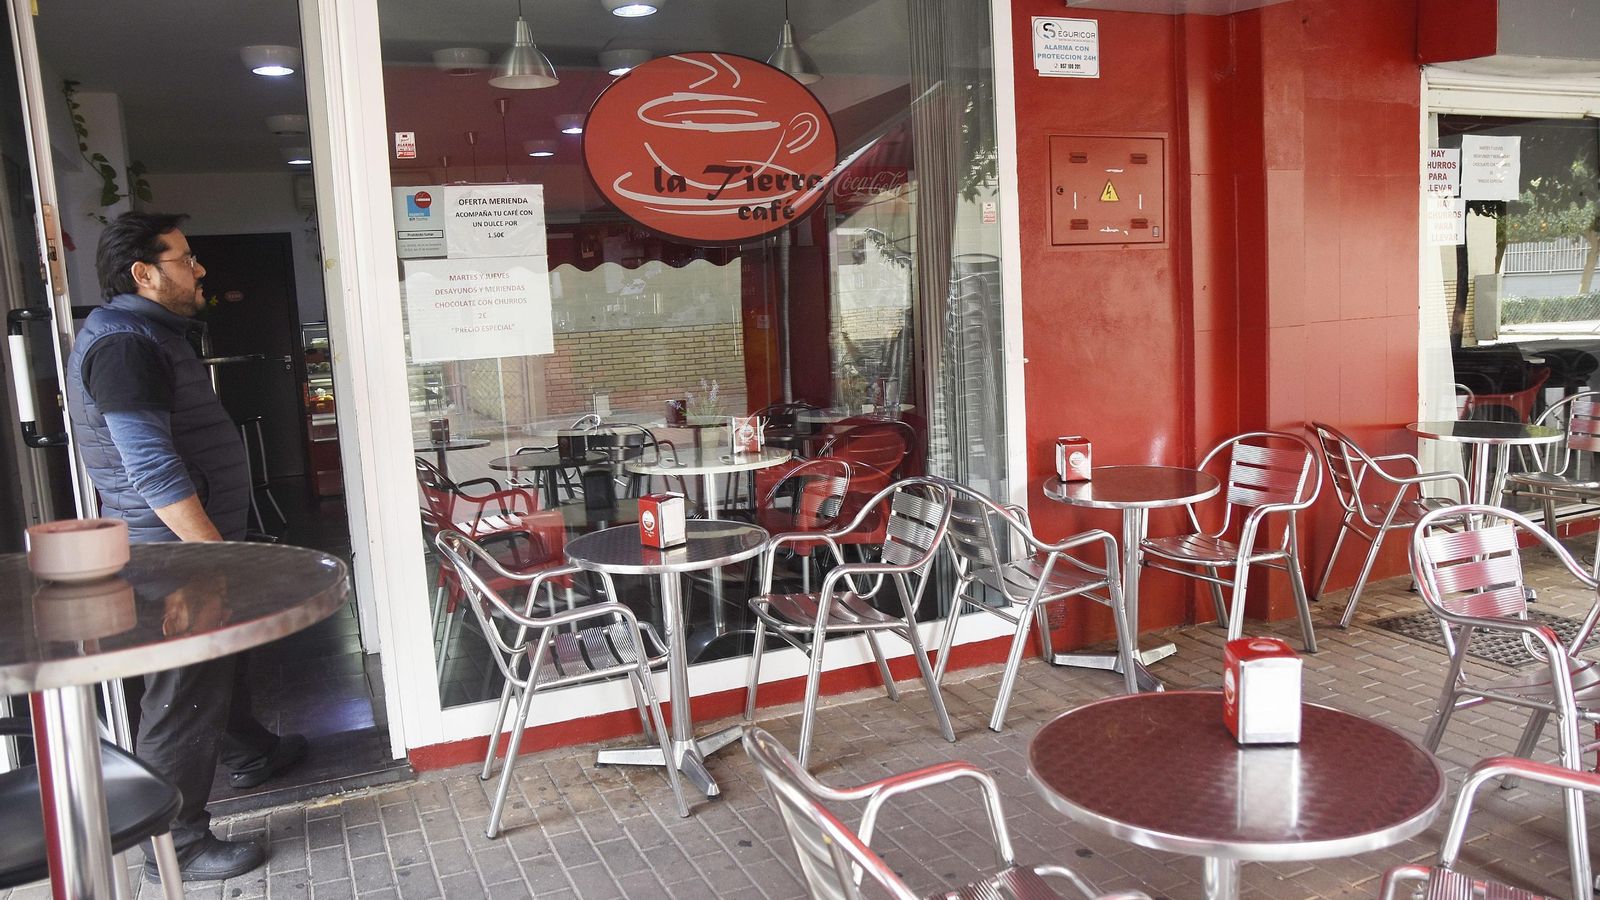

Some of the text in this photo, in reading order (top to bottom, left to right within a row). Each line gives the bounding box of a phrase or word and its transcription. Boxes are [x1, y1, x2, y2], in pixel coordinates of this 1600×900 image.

[1431, 150, 1446, 158] HAY
[1427, 162, 1457, 170] HURROS
[1428, 173, 1448, 181] PARA
[654, 164, 825, 201] la Tierra
[458, 197, 528, 206] OFERTA MERIENDA
[455, 209, 493, 218] ACOMPAÑA
[503, 208, 519, 216] CAFÉ
[737, 198, 796, 222] café
[487, 231, 505, 239] 1.50€
[449, 273, 478, 281] MARTES
[485, 272, 510, 280] JUEVES
[435, 287, 478, 296] DESAYUNOS
[484, 284, 525, 293] MERIENDAS
[434, 300, 476, 309] CHOCOLATE
[494, 297, 528, 306] CHURROS
